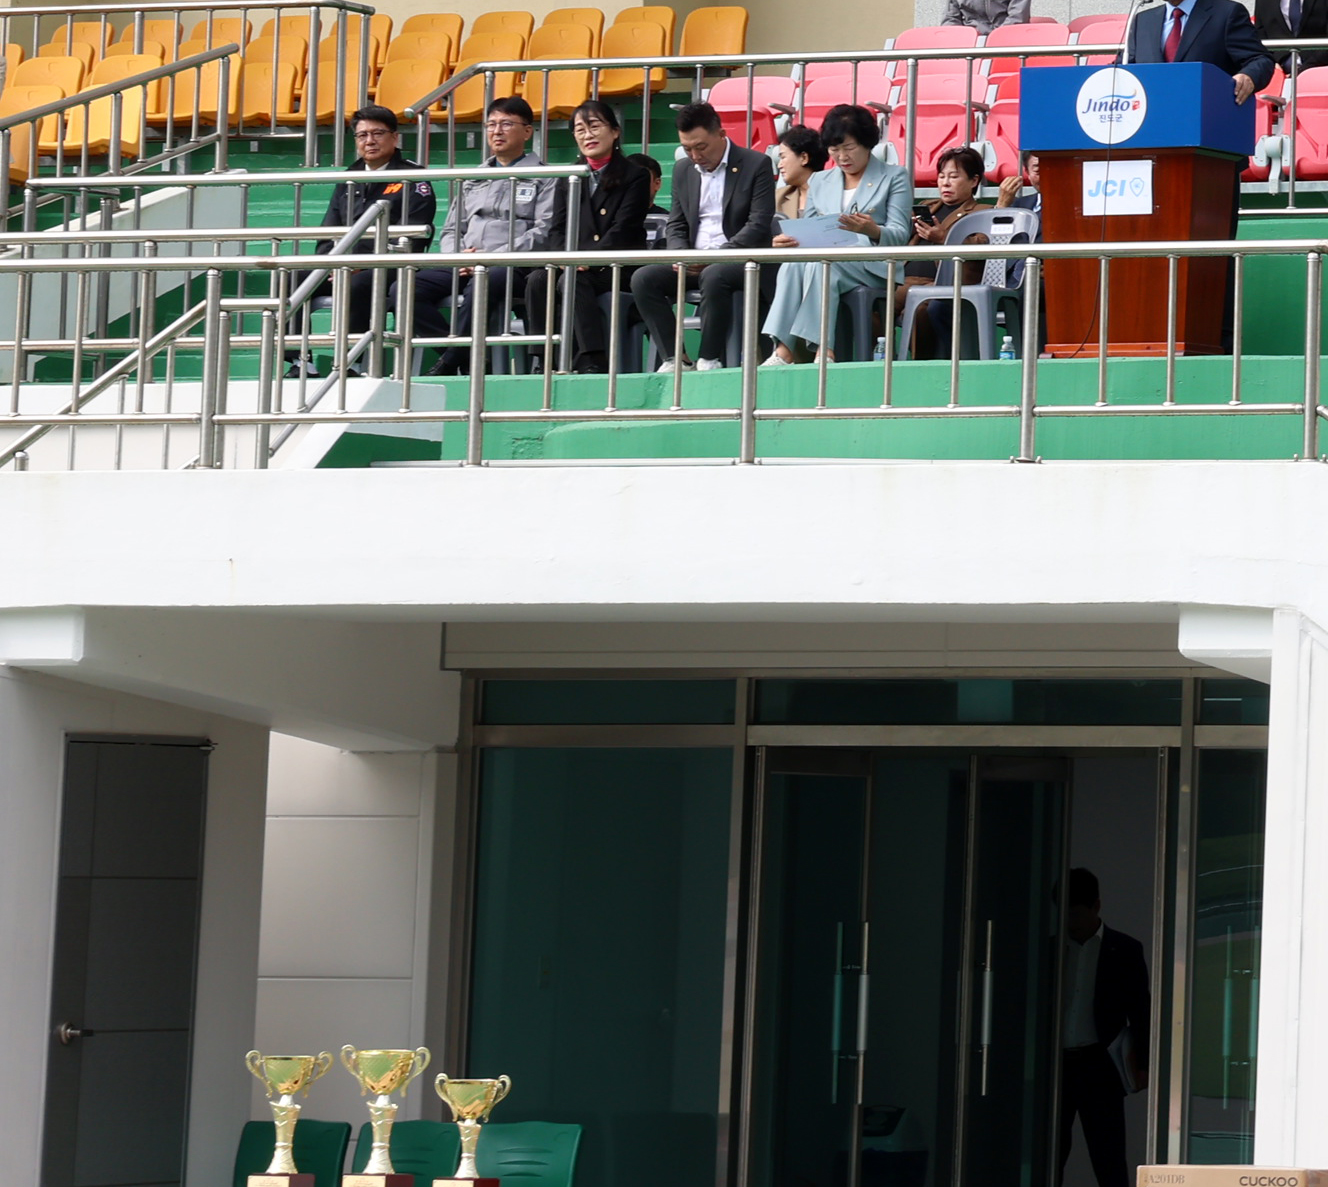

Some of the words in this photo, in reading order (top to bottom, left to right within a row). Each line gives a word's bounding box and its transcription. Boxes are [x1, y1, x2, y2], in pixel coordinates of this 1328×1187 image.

[1082, 98, 1130, 114] Jindo
[1099, 114, 1123, 123] 진도군
[1088, 179, 1126, 198] JCI
[1239, 1175, 1298, 1187] CUCKOO
